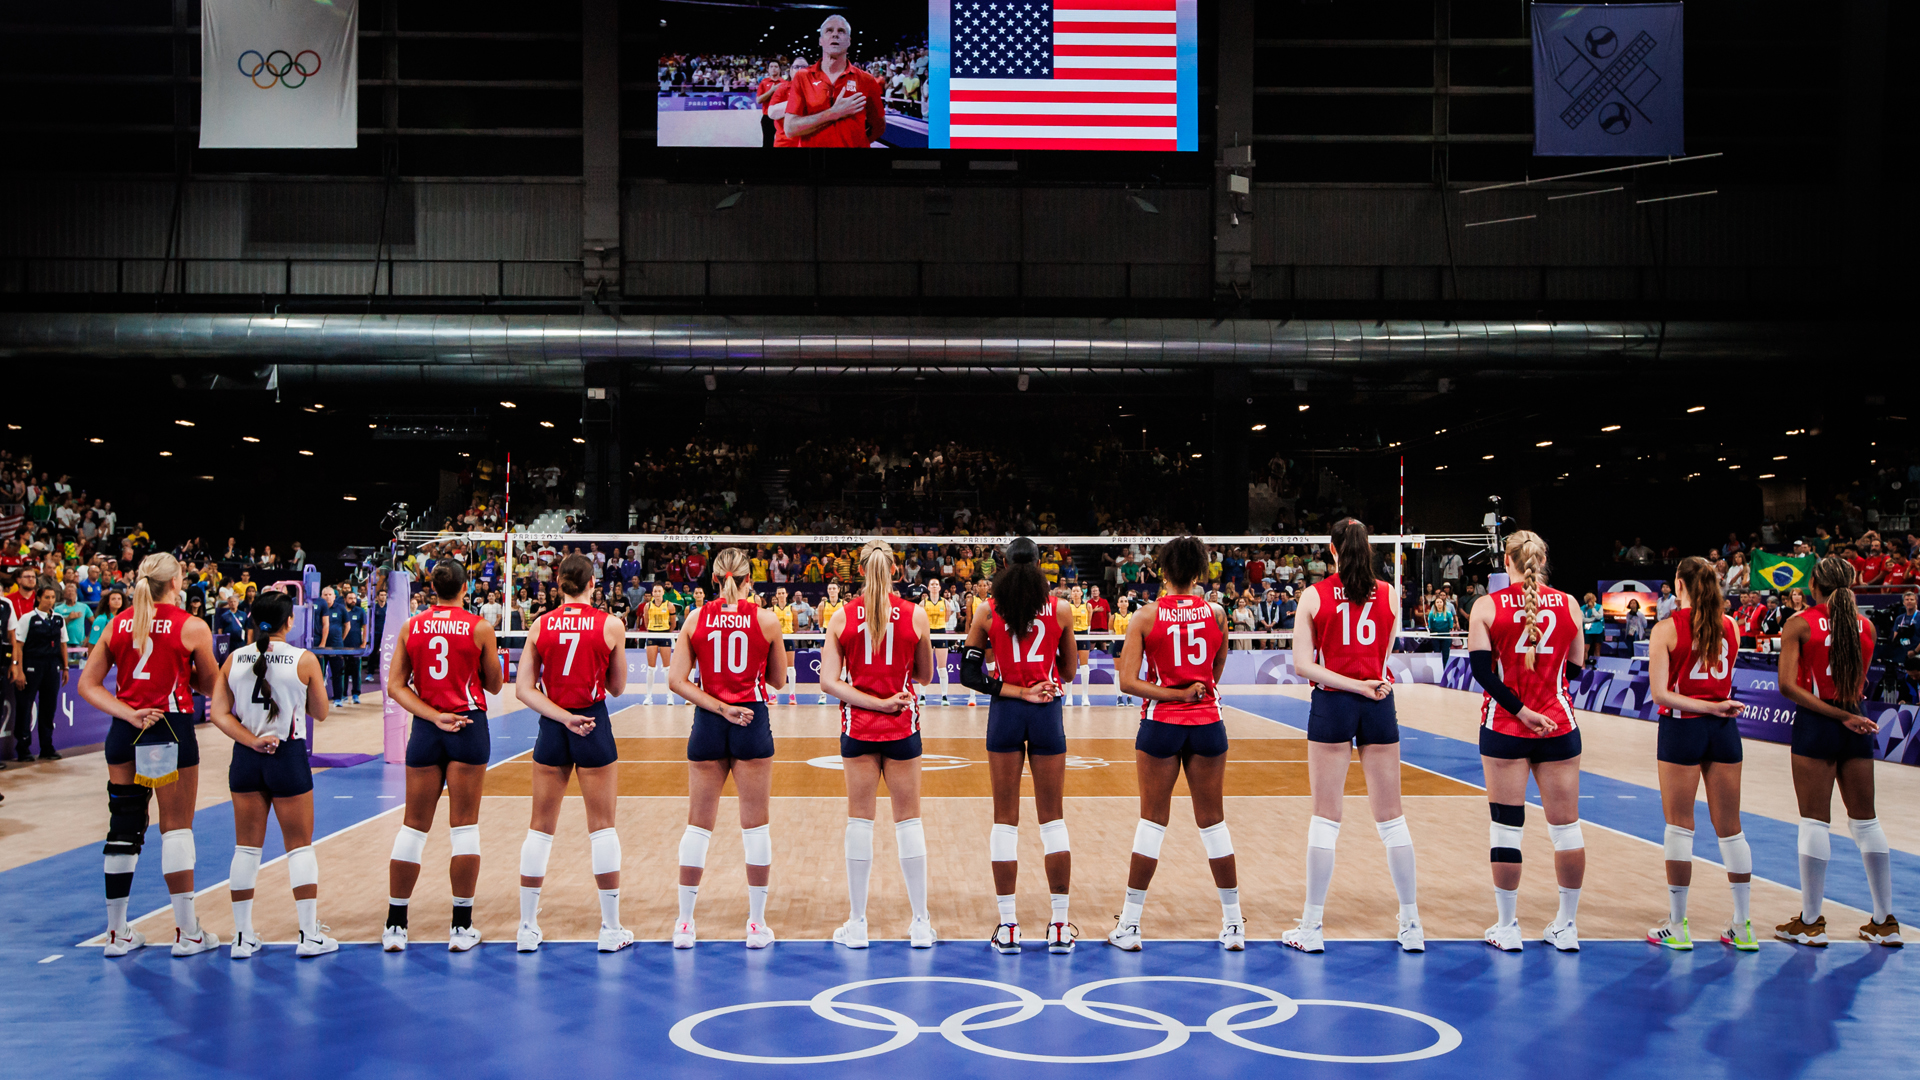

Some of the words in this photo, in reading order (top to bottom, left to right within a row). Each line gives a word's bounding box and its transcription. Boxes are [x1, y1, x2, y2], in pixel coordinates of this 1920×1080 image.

[705, 614, 751, 629] LARSON
[1158, 603, 1212, 622] WASHINGTON
[1500, 593, 1564, 608] PLUMER
[412, 622, 420, 634] A.
[423, 620, 470, 635] SKINNER
[547, 616, 594, 631] CARLINI
[857, 621, 894, 666] 11
[1166, 621, 1207, 667] 15
[1336, 602, 1376, 646] 16
[1513, 609, 1557, 654] 22
[132, 636, 154, 680] 2
[428, 635, 449, 680] 3
[559, 632, 580, 676] 7
[707, 630, 749, 674] 10
[251, 675, 271, 711] 4
[1742, 704, 1770, 722] ARIS
